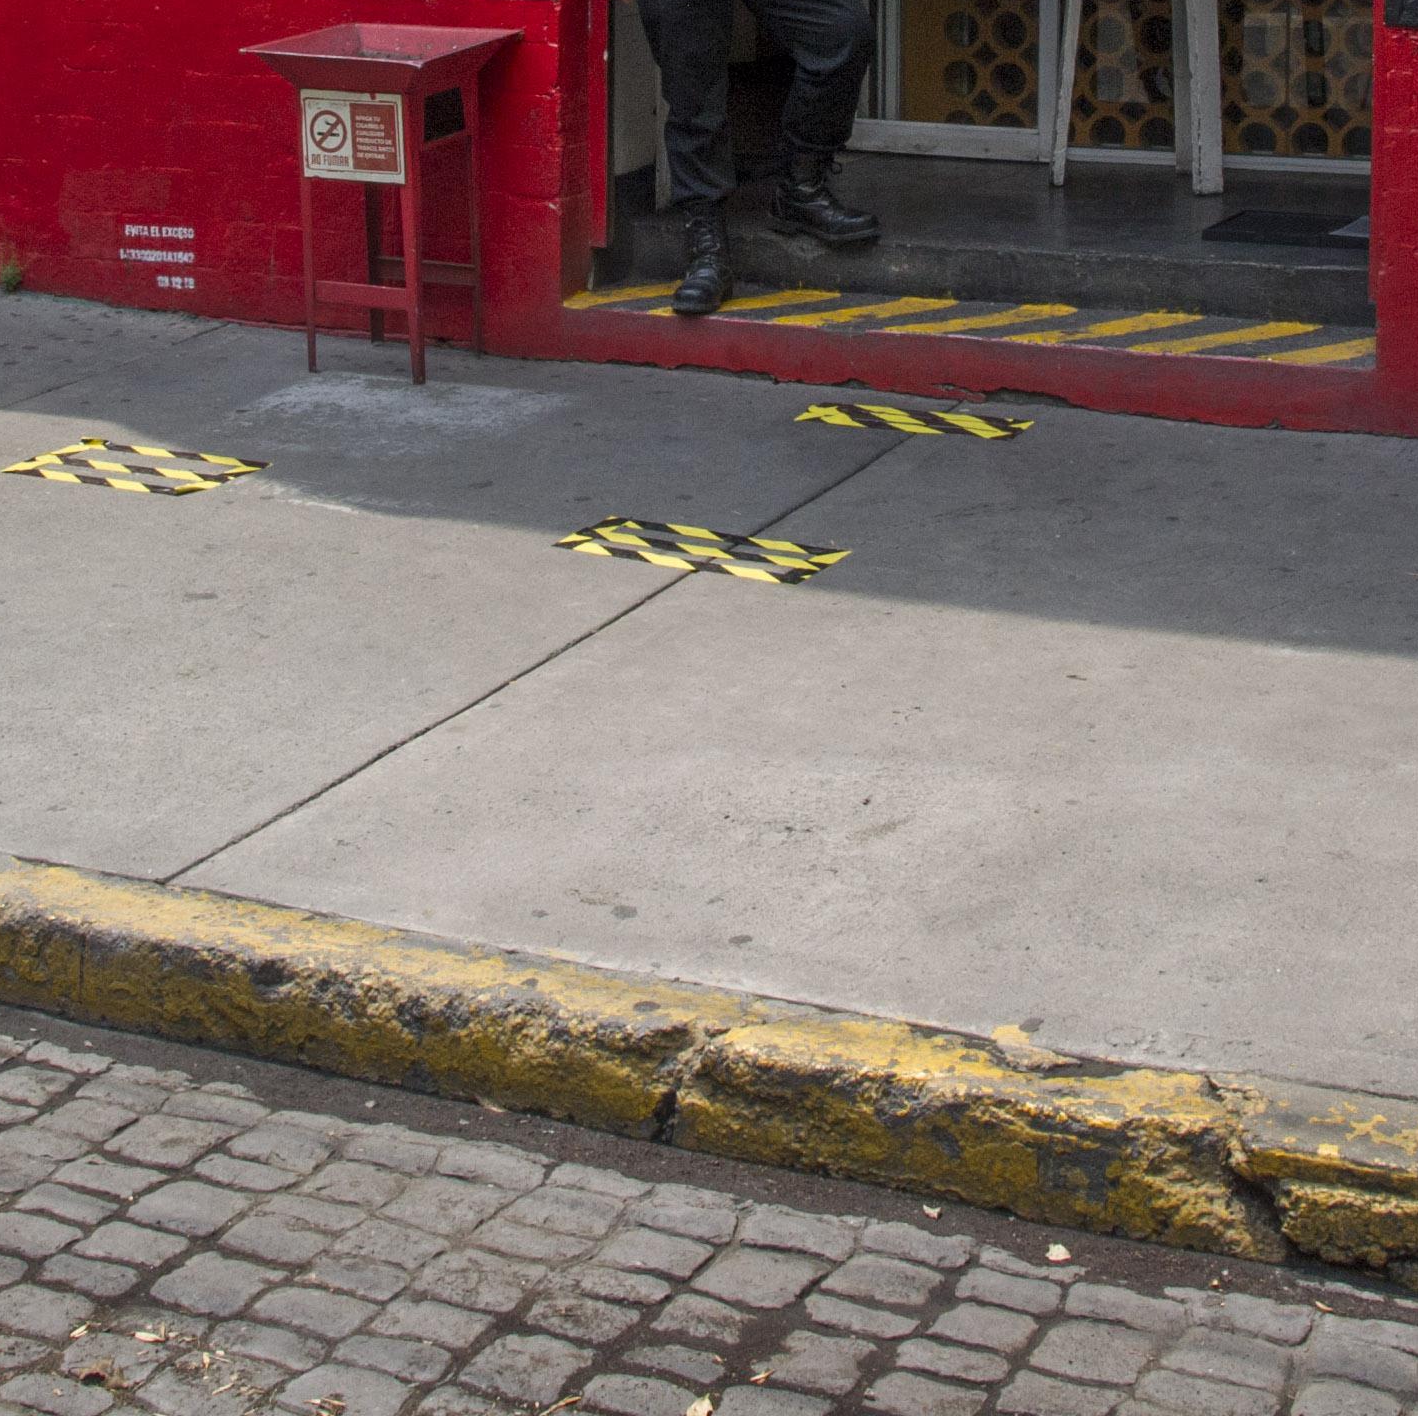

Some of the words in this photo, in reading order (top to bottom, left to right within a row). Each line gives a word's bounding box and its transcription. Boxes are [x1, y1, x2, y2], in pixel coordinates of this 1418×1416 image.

[323, 155, 349, 167] FUMAR
[150, 226, 160, 237] EL
[161, 226, 195, 239] EXCESO
